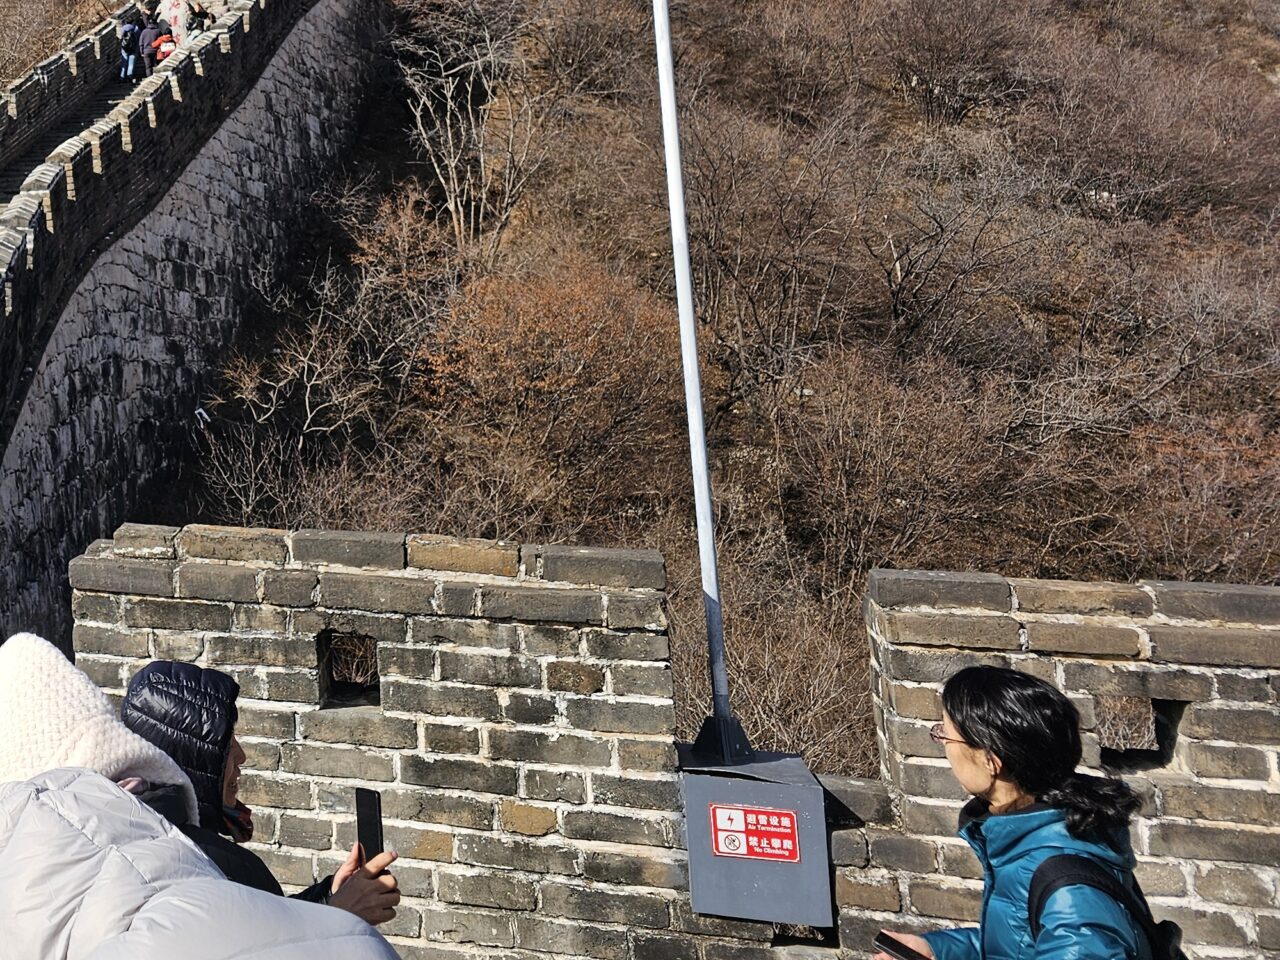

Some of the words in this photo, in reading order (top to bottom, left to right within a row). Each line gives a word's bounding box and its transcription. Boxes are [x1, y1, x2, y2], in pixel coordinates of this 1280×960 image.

[757, 825, 792, 833] Termination
[748, 836, 793, 850] 禁止攀爬
[763, 848, 790, 856] Climbing
